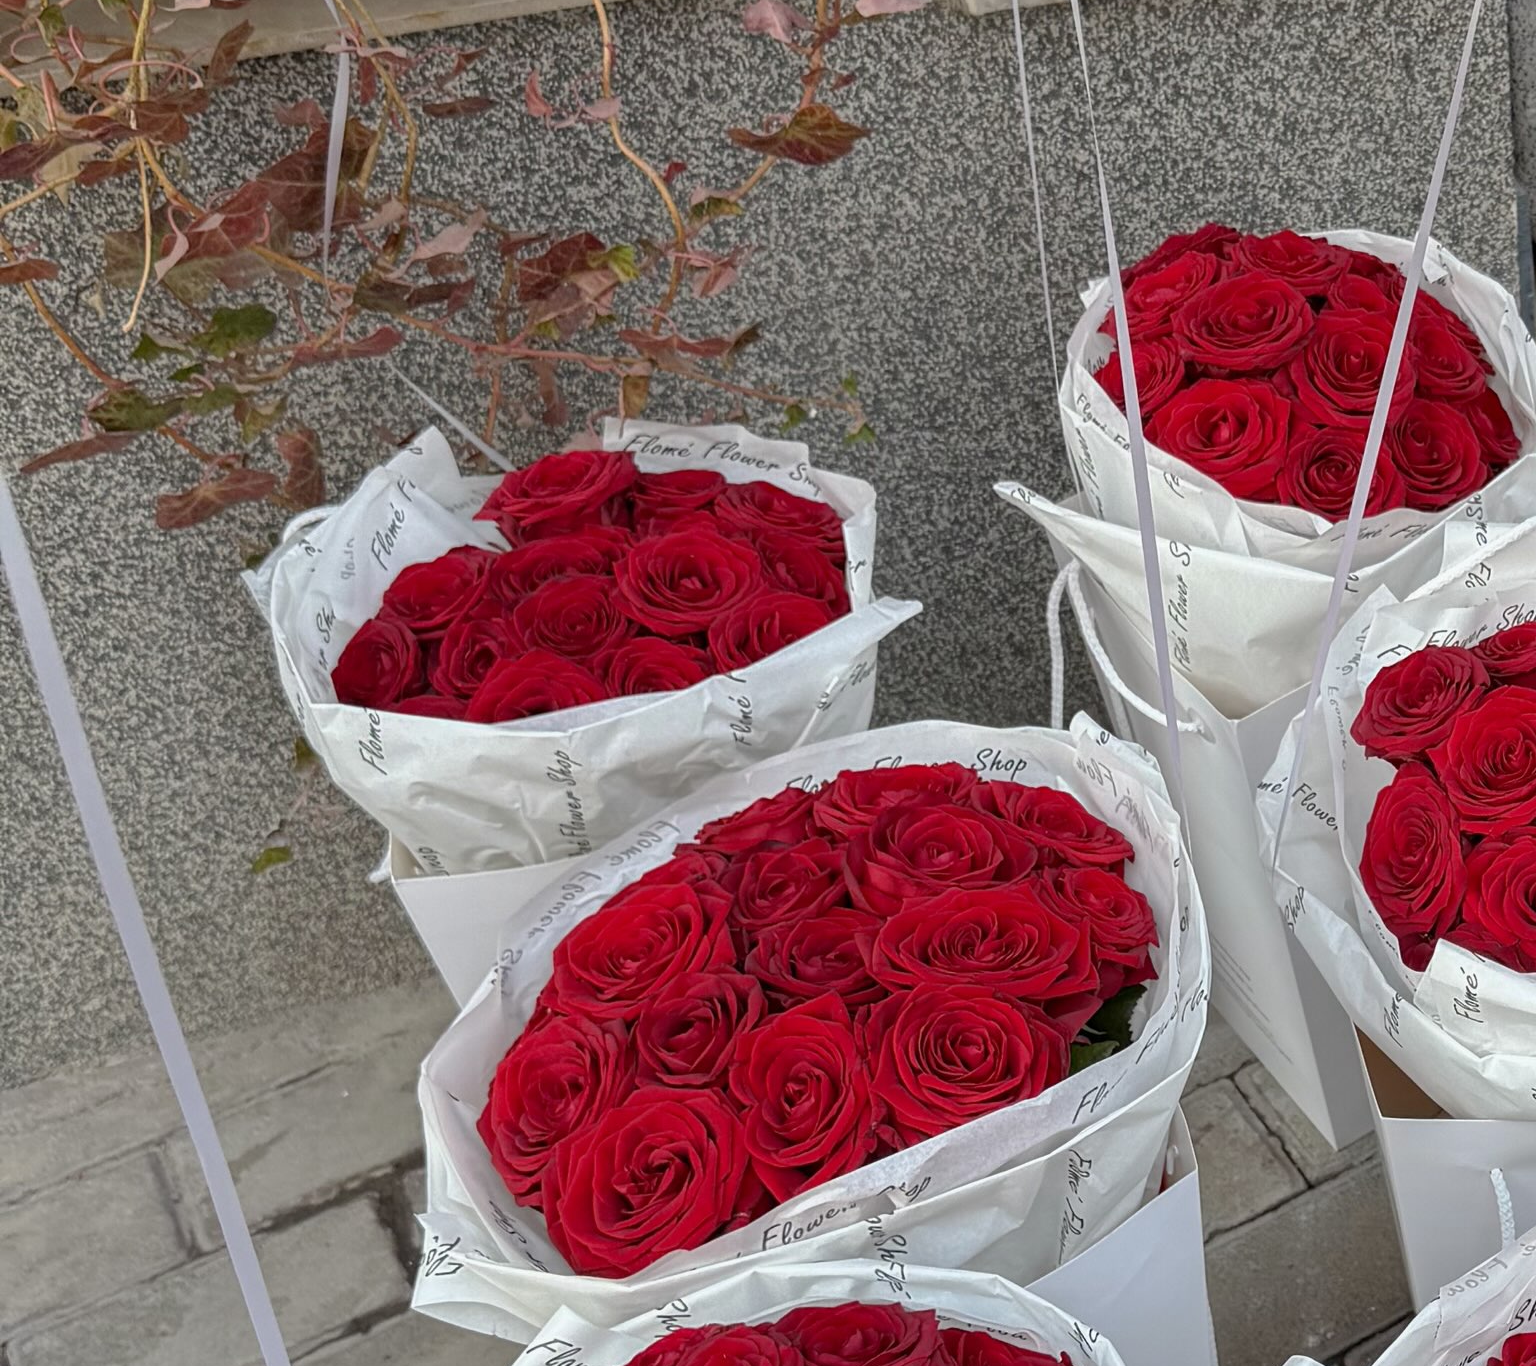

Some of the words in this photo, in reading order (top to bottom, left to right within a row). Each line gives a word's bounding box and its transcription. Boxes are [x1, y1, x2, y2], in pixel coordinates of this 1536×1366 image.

[623, 434, 692, 459] Flomé
[703, 440, 781, 471] Flower
[371, 502, 406, 572] Flomé
[1167, 572, 1190, 633] Flower
[546, 749, 583, 786] Shop
[971, 747, 1028, 774] Shop
[559, 790, 587, 844] Flower
[1280, 885, 1305, 933] Shop
[1451, 965, 1485, 1024] Flomé
